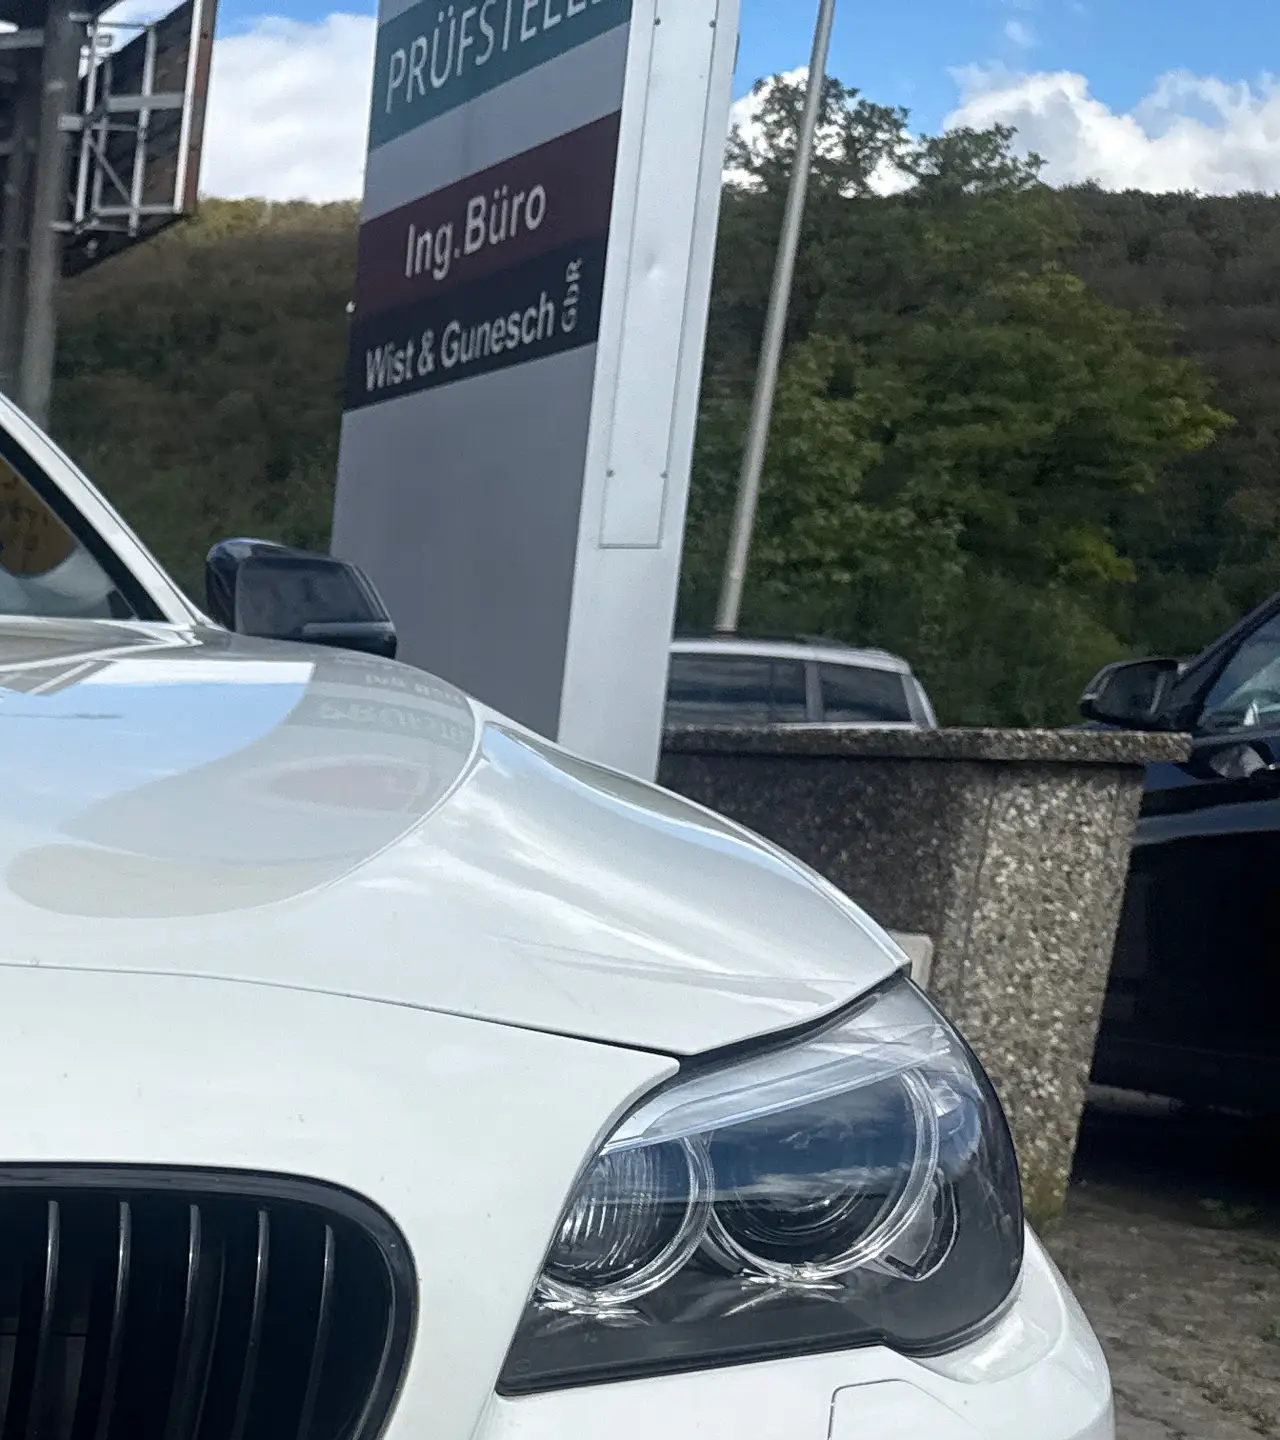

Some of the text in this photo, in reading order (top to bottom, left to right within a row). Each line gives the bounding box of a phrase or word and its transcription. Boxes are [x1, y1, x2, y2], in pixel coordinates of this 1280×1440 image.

[385, 0, 602, 114] PRÜFSTEL
[366, 291, 554, 391] Wist & Gunesch
